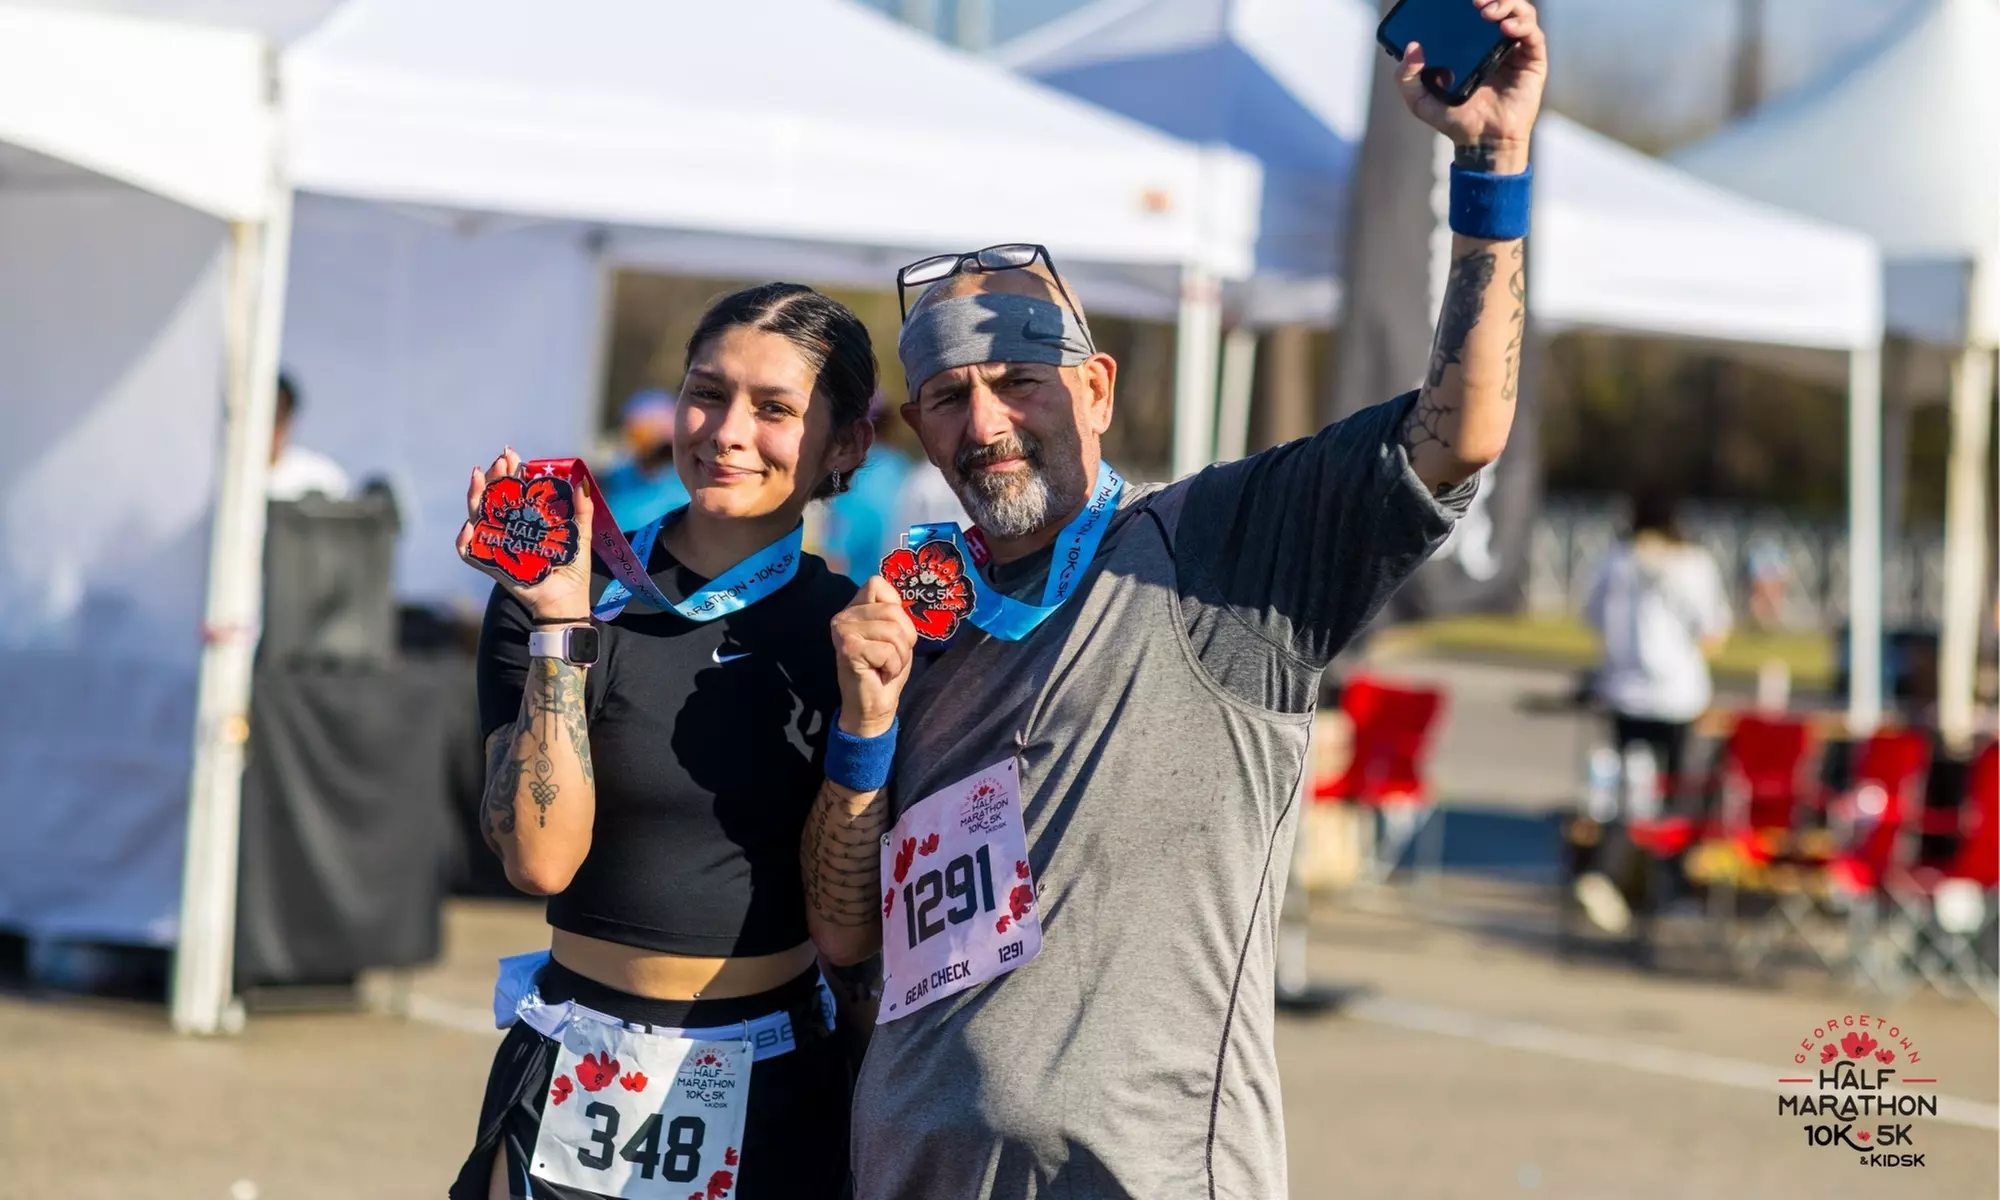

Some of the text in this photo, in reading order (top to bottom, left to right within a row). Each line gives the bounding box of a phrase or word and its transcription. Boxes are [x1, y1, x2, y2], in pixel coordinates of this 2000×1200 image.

[1076, 486, 1112, 536] MARATHON
[504, 520, 547, 541] HALF
[600, 531, 616, 548] 5K
[478, 531, 568, 561] MARATHON
[617, 547, 634, 575] 10K
[1059, 546, 1081, 581] 10K
[686, 551, 795, 617] ARATHON 10K 5K
[901, 588, 956, 603] 10K 5K
[1056, 581, 1069, 599] 5K
[960, 798, 1009, 827] MARATHON
[972, 794, 996, 812] HALF
[968, 811, 1002, 834] 10K 5K
[903, 844, 996, 950] 1291
[998, 940, 1024, 963] 1291
[905, 960, 971, 1006] GEAR CHECK
[694, 1065, 723, 1078] HALF
[677, 1078, 736, 1090] MARATHON
[685, 1090, 726, 1102] 10K 5K
[577, 1101, 706, 1183] 348
